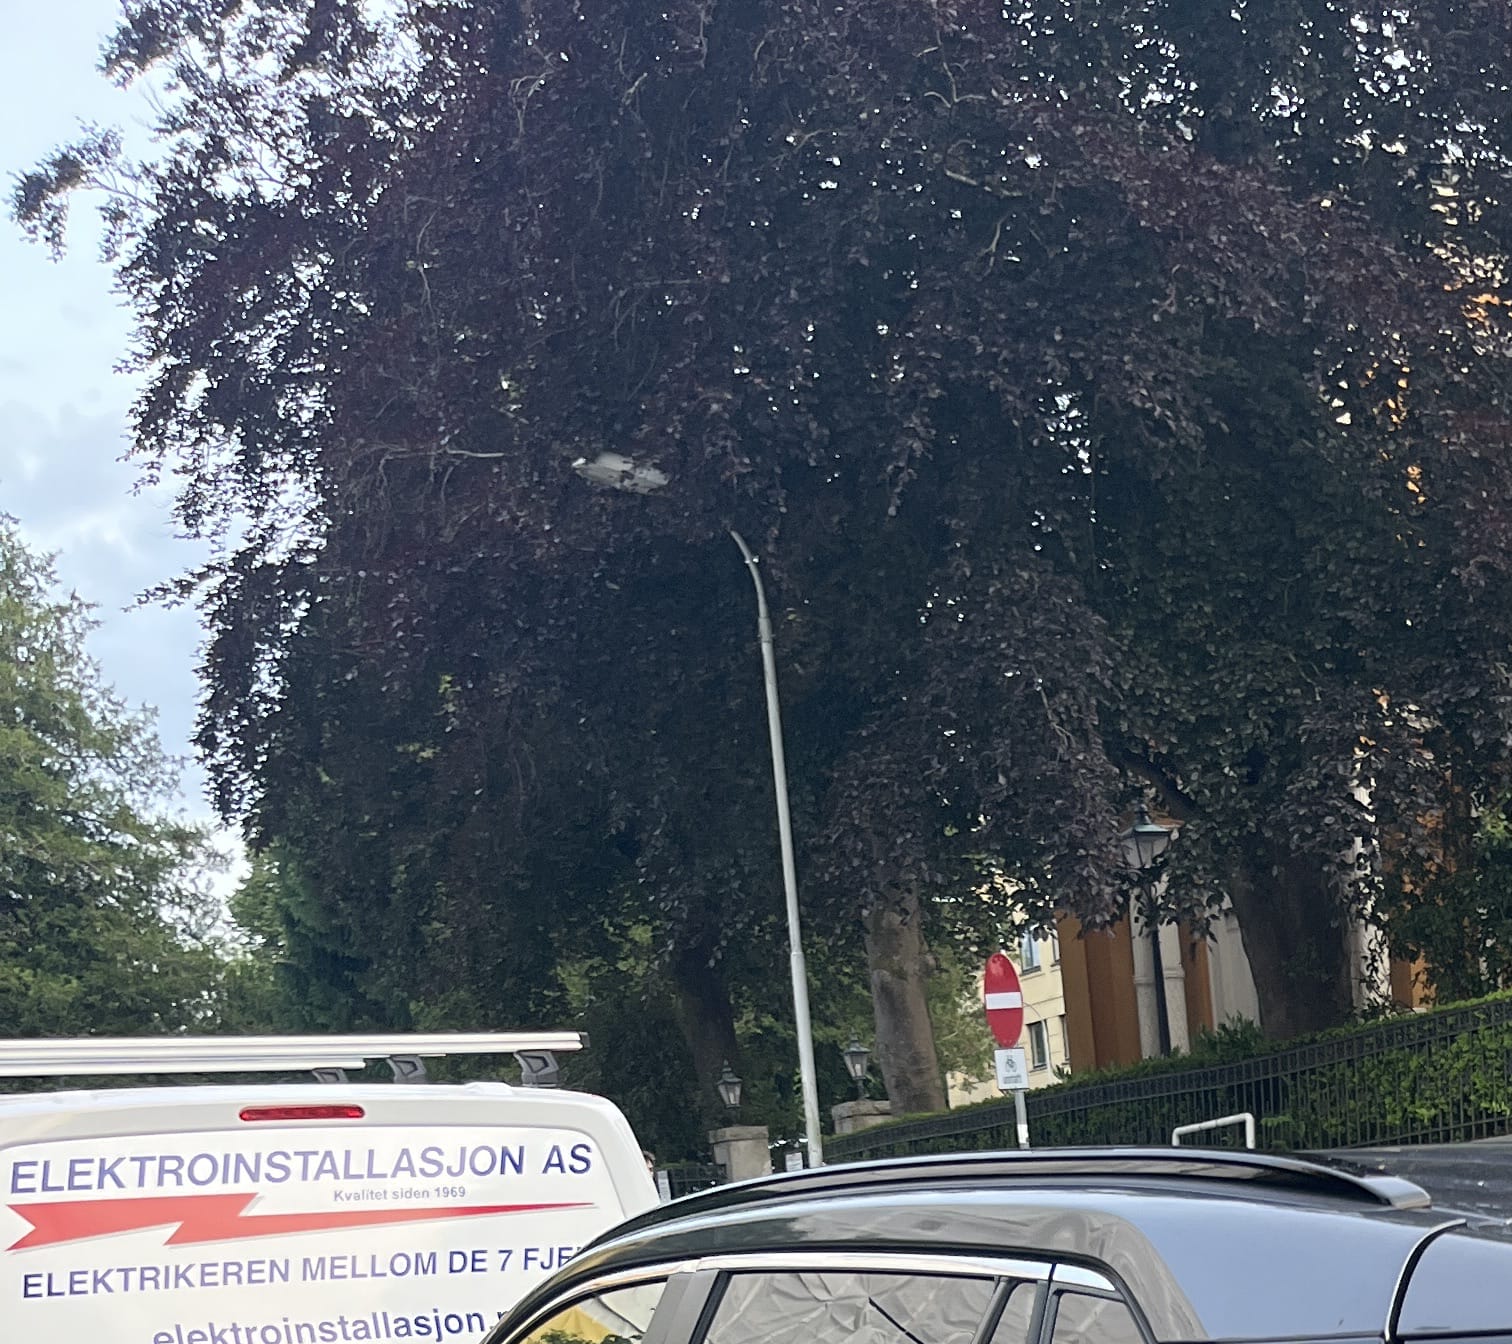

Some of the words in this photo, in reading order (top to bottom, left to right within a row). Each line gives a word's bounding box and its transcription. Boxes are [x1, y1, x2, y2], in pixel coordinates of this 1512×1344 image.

[10, 1145, 525, 1194] ELEKTROINSTALLASJON
[542, 1143, 592, 1175] AS
[333, 1189, 388, 1202] Kvalitet
[391, 1187, 430, 1200] siden
[434, 1186, 466, 1198] 1969
[23, 1258, 290, 1298] ELEKTRIKEREN
[302, 1251, 437, 1281] MELLOM
[449, 1249, 488, 1274] DE
[498, 1249, 513, 1272] 7
[523, 1246, 581, 1270] FJE
